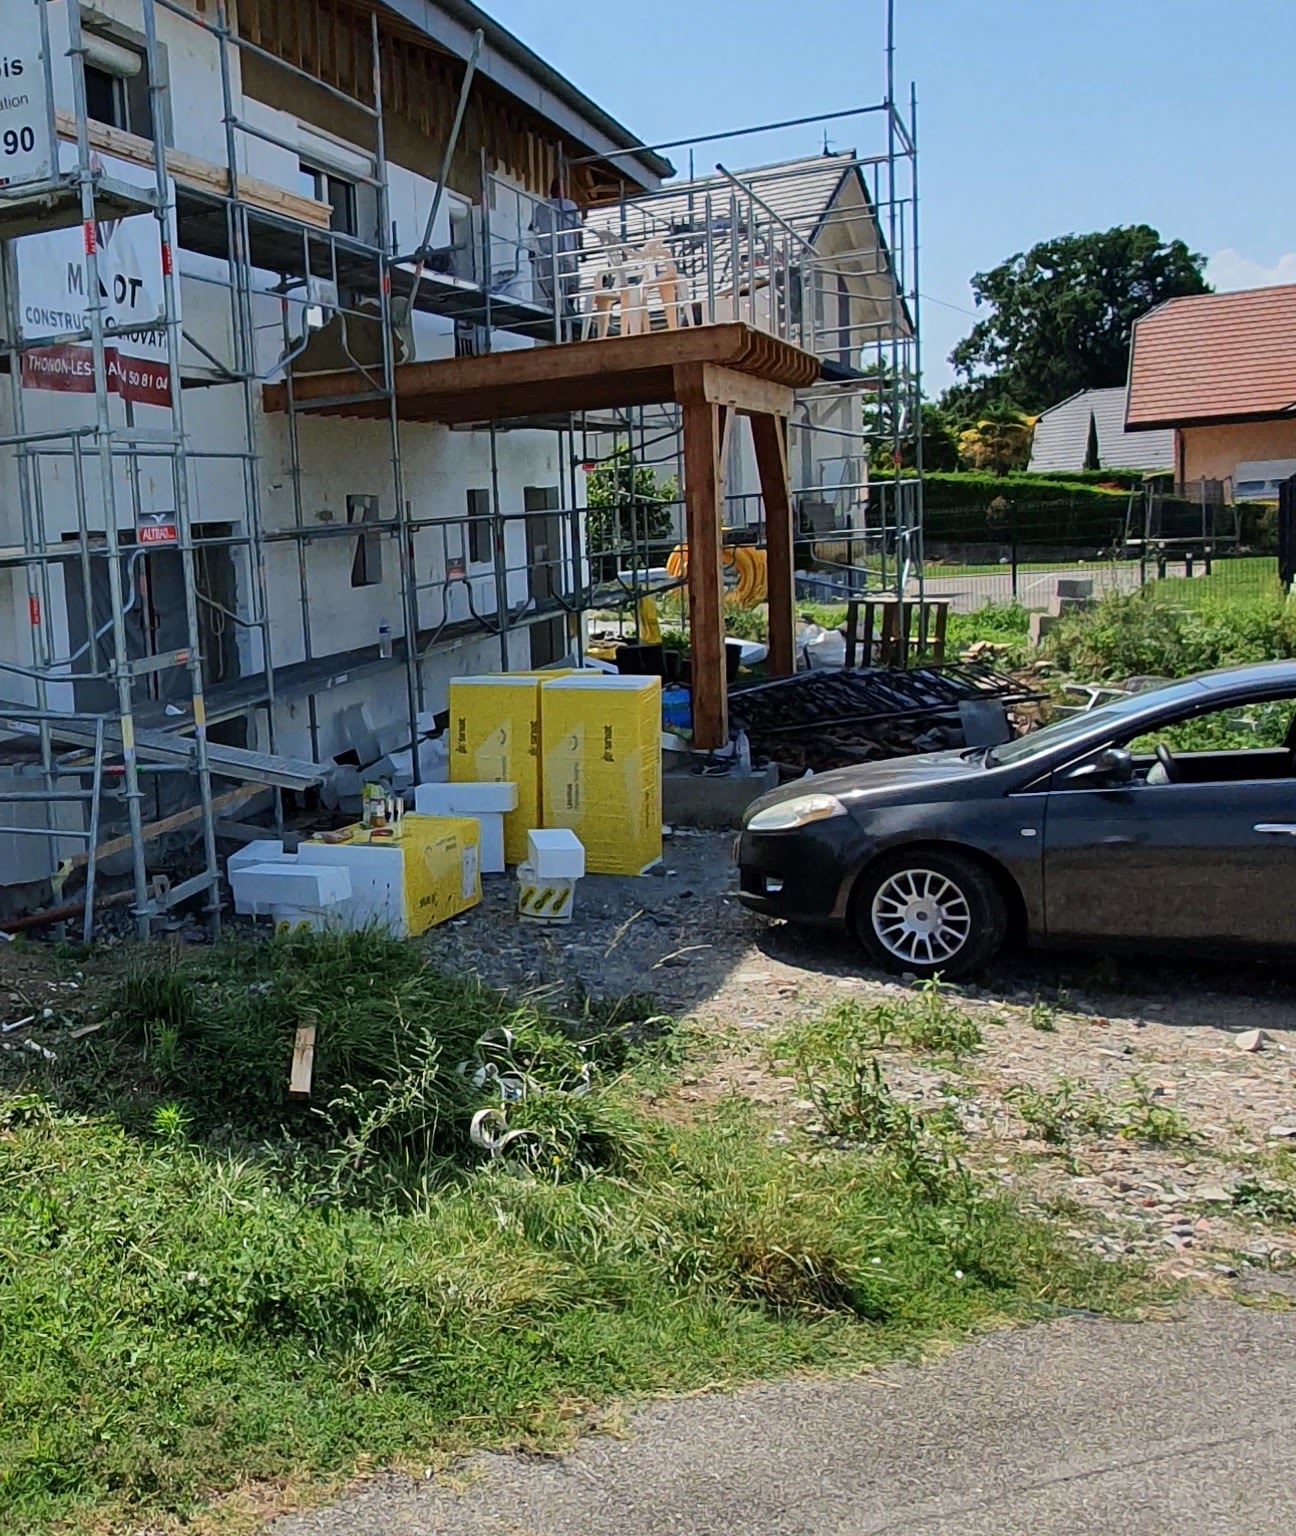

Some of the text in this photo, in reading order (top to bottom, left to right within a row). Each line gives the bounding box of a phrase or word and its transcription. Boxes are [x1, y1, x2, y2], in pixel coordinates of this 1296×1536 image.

[3, 126, 36, 155] 90
[128, 370, 140, 386] 50
[141, 373, 153, 388] 81
[155, 376, 168, 391] 04
